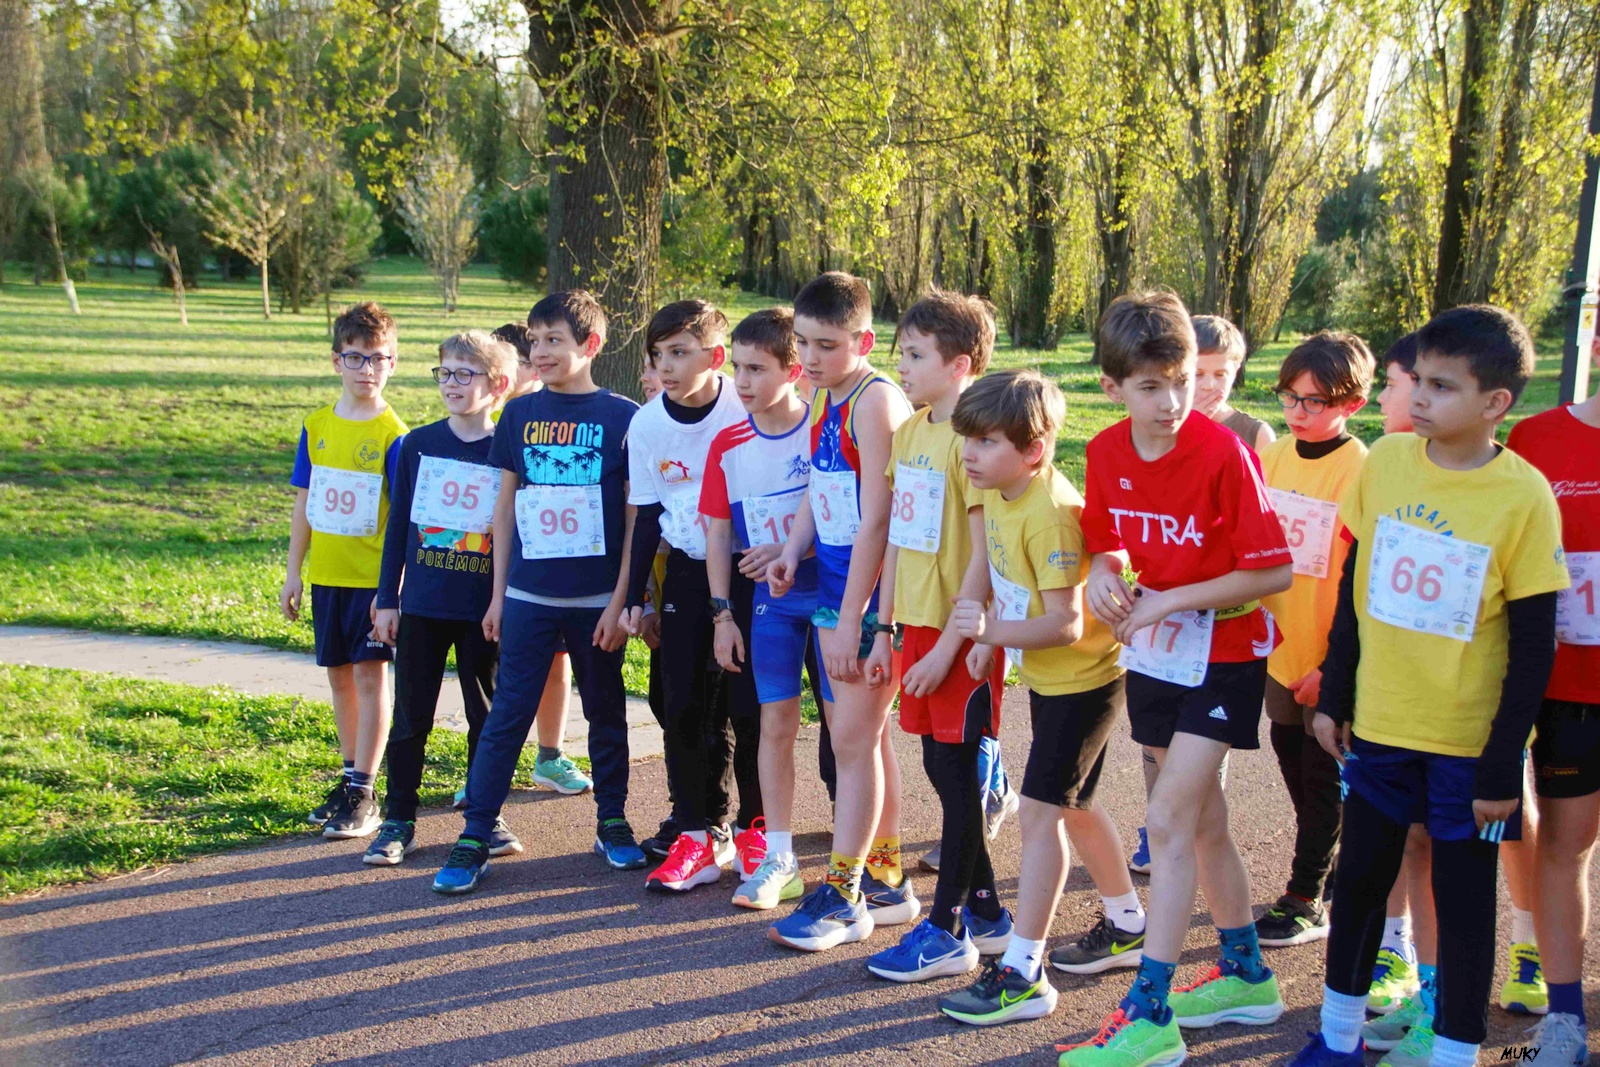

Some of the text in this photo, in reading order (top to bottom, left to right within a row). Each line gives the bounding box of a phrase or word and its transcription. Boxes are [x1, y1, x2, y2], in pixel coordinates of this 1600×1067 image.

[324, 487, 356, 515] 99
[441, 480, 480, 510] 95
[539, 508, 579, 535] 96
[416, 548, 491, 574] POKÉMON
[1390, 556, 1444, 602] 66
